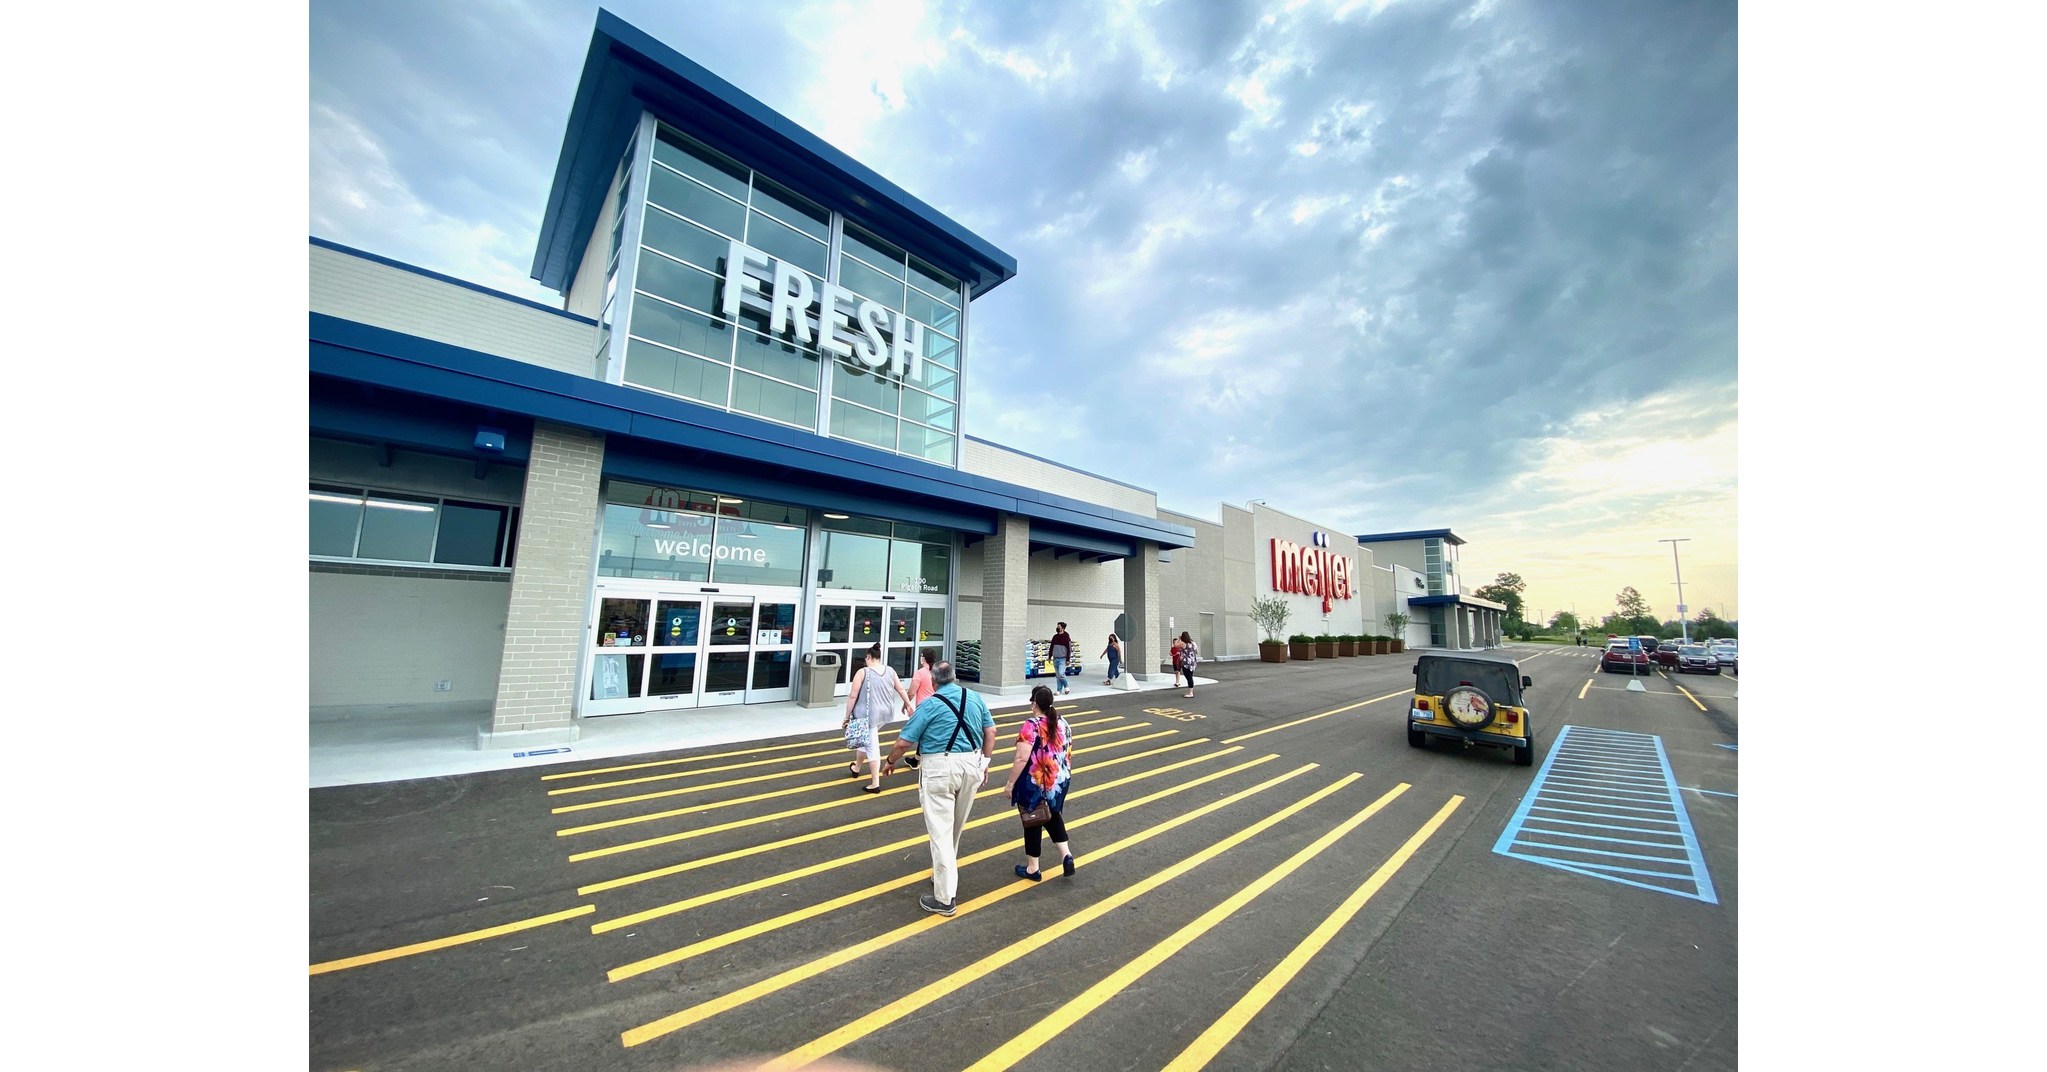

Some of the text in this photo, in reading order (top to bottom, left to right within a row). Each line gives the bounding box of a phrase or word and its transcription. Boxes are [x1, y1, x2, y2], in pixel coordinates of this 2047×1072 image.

[722, 240, 925, 382] FRESH
[654, 538, 766, 563] welcome
[1271, 531, 1354, 613] meijer
